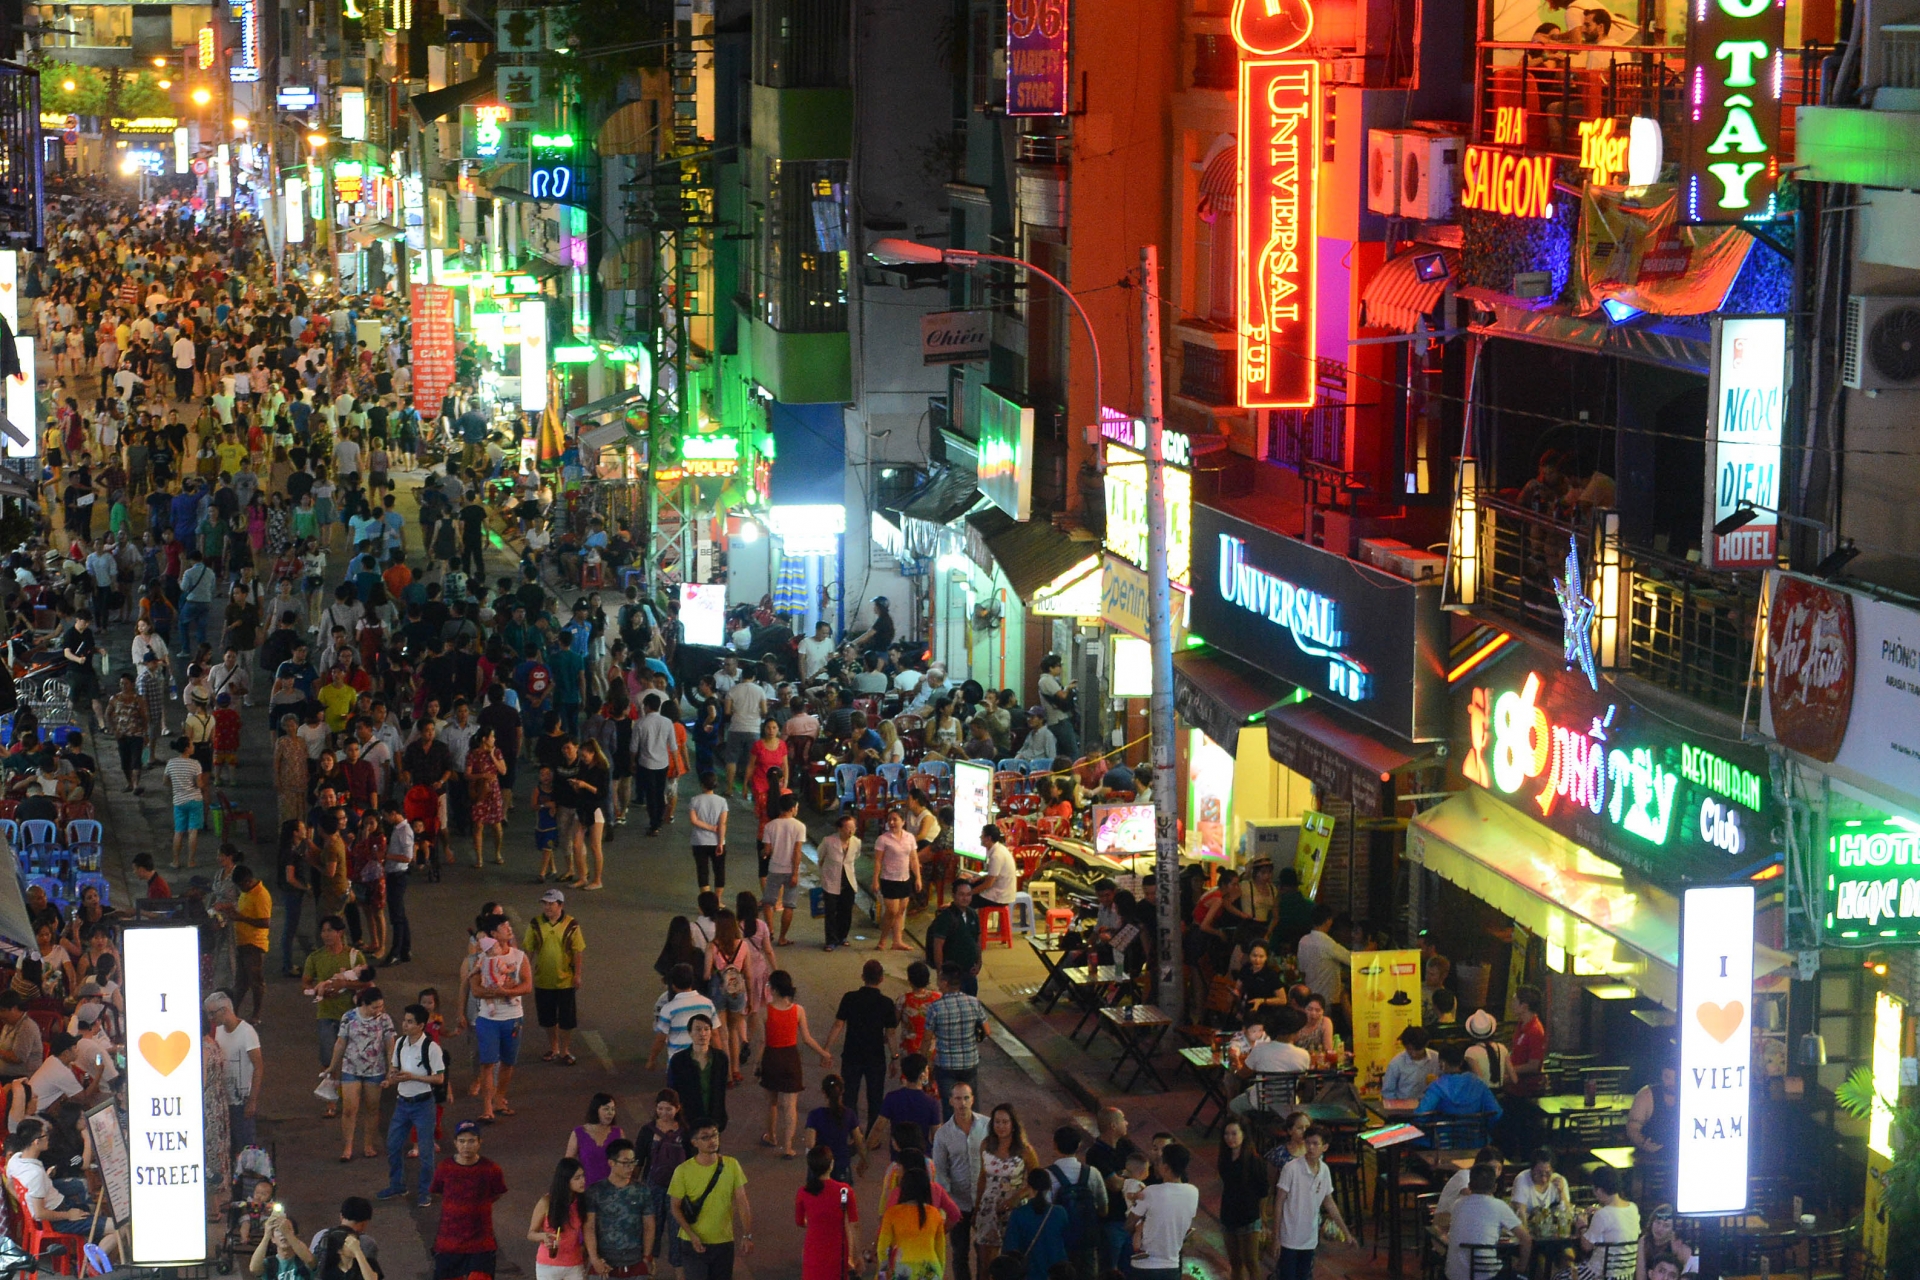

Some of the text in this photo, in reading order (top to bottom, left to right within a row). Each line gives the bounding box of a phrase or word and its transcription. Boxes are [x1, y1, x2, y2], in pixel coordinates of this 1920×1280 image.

[1013, 49, 1060, 75] VARIETY
[1017, 81, 1055, 108] STORE
[1494, 106, 1523, 145] BIA
[1706, 40, 1768, 209] TÂY
[1578, 117, 1629, 186] Tiger
[1462, 147, 1552, 219] SAIGON
[1247, 322, 1266, 384] PUB
[685, 460, 735, 473] VIOLET
[1718, 531, 1772, 561] HOTEL
[1219, 533, 1341, 647] UNIVERSAL
[1329, 661, 1363, 701] PUB
[1700, 797, 1740, 854] Club
[1839, 832, 1920, 866] HOT
[1720, 956, 1728, 977] I
[160, 993, 168, 1012] I
[1692, 1066, 1745, 1089] VIET
[151, 1097, 182, 1116] BUI
[146, 1131, 188, 1151] VIEN
[1693, 1115, 1742, 1139] NAM
[136, 1164, 199, 1186] STREET
